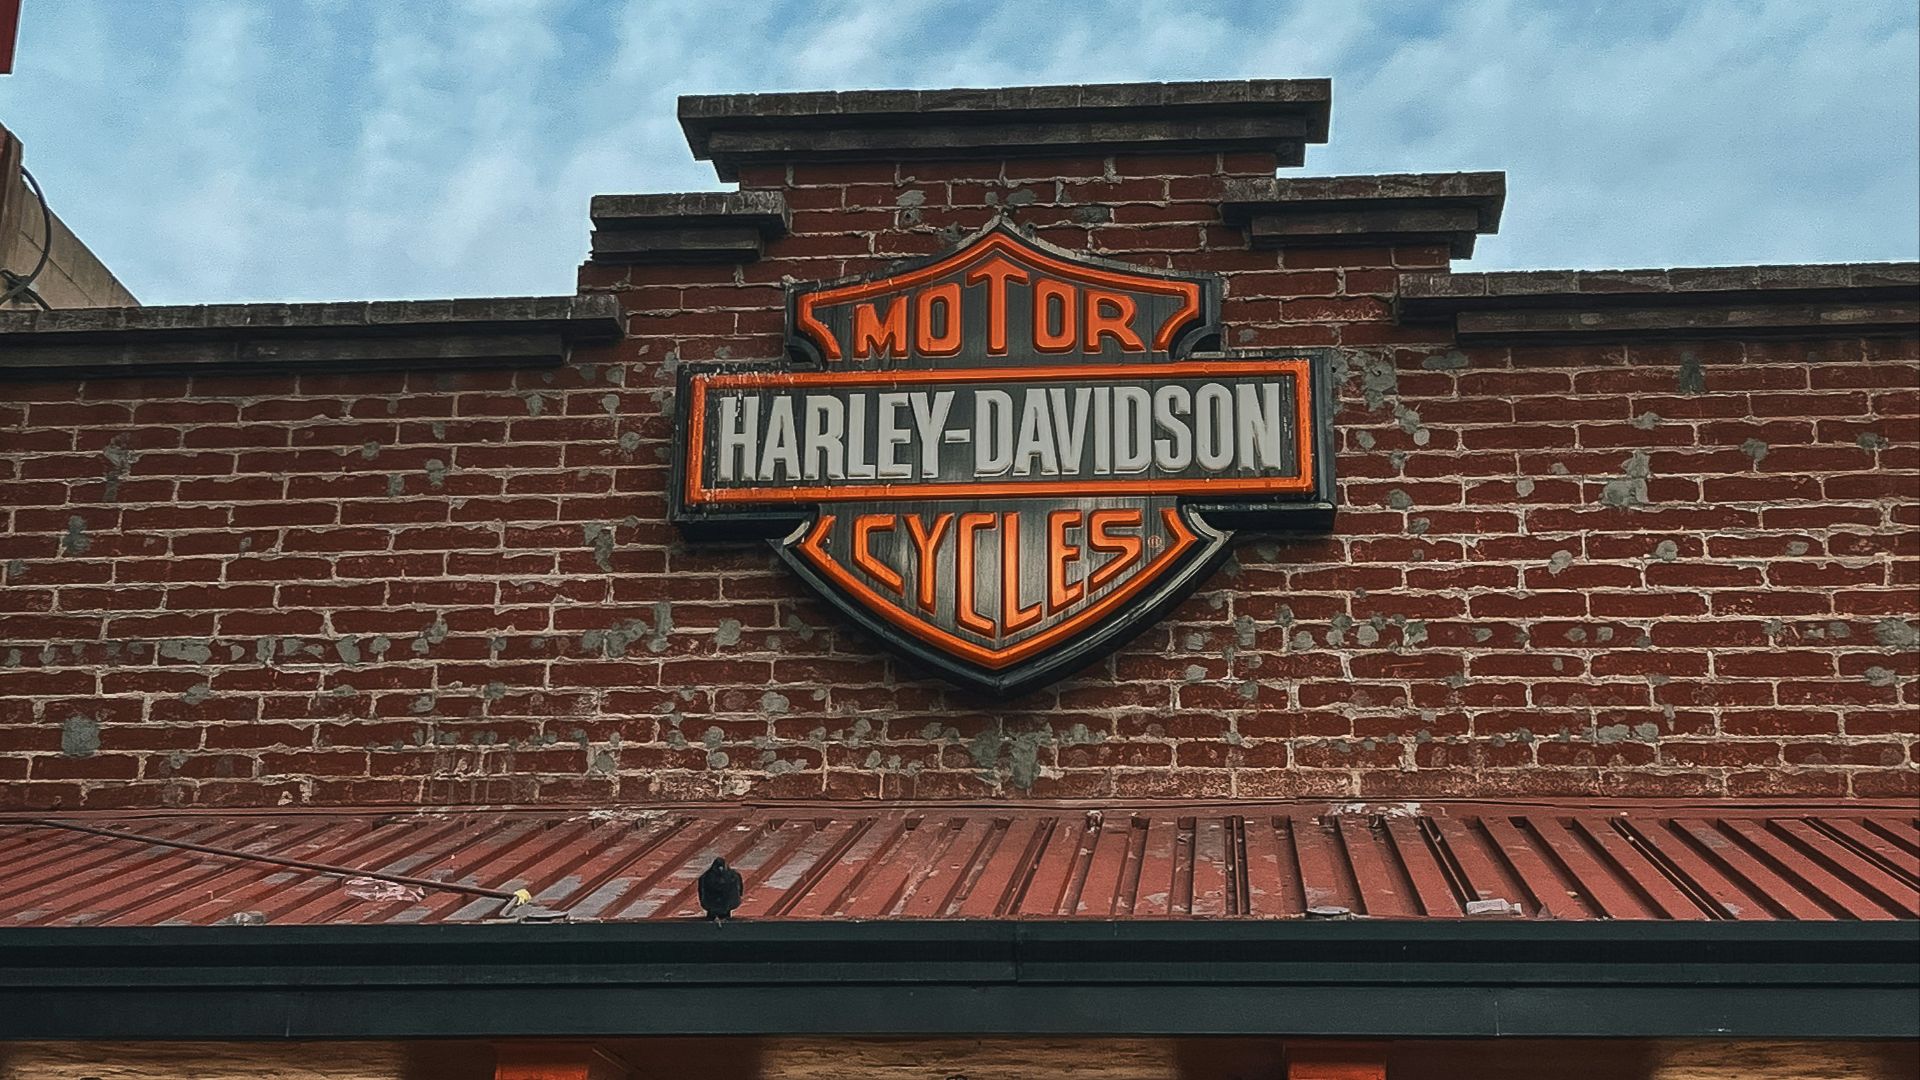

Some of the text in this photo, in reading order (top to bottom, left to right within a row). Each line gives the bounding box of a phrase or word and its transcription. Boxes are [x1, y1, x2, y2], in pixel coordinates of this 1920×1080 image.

[855, 257, 1146, 359] MOTOR
[719, 383, 1281, 482] HARLEY-DAVIDSON
[852, 508, 1143, 638] CYCLES
